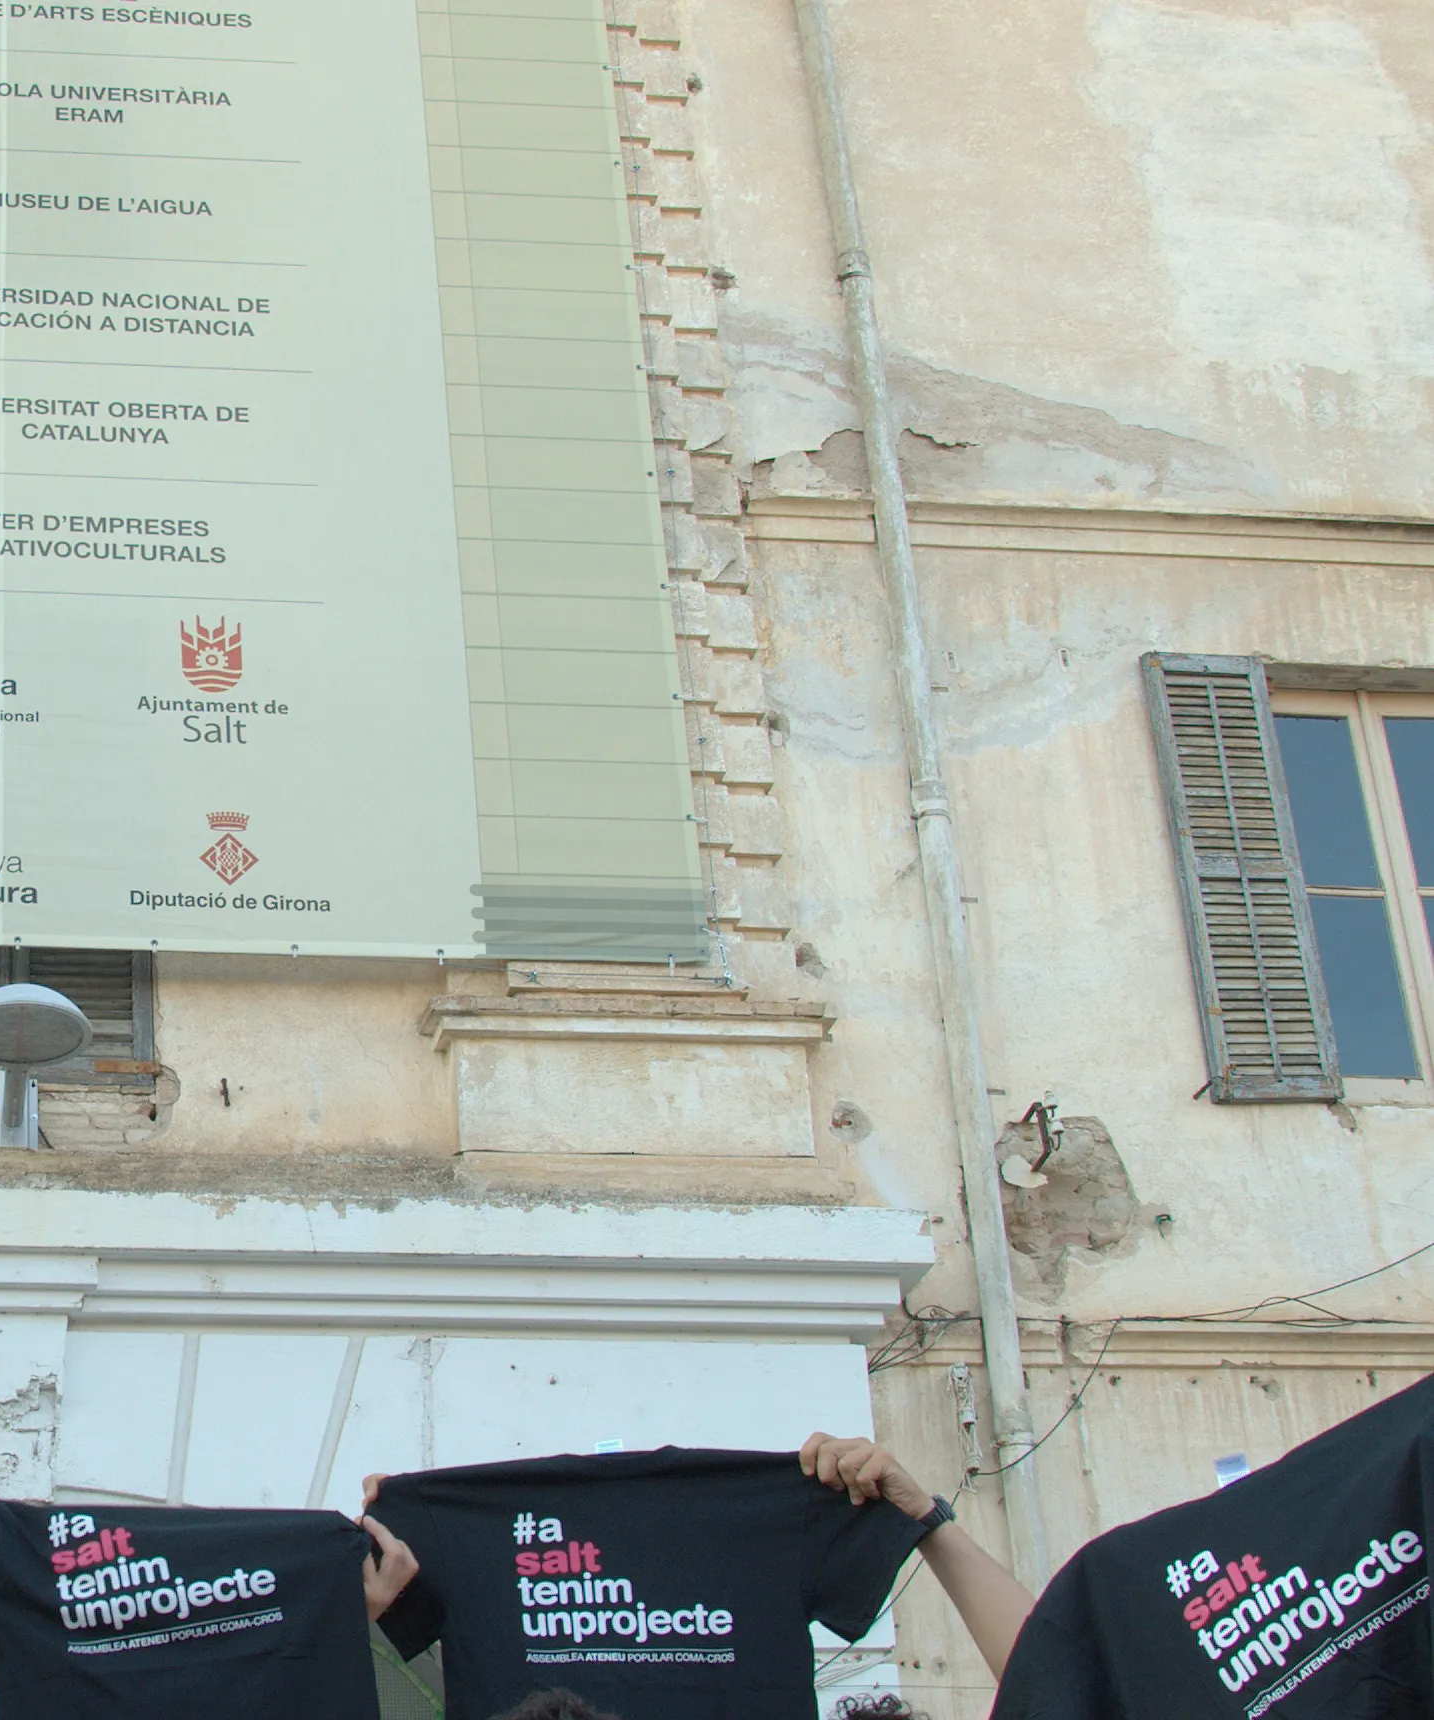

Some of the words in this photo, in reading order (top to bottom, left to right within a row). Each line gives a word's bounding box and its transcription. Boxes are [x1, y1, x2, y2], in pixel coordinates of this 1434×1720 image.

[10, 4, 94, 21] D'ARTS
[101, 6, 252, 28] ESCÈNIQUES
[51, 85, 232, 106] UNIVERSITÀRIA
[55, 107, 123, 123] ERAM
[78, 196, 110, 211] DE
[118, 198, 212, 216] L'AIGUA
[102, 292, 229, 312] NACIONAL
[238, 298, 270, 313] DE
[100, 316, 116, 331] A
[124, 317, 254, 336] DISTANCIA
[108, 402, 208, 421] OBERTA
[216, 407, 249, 422] DE
[21, 423, 168, 444] CATALUNYA
[43, 515, 209, 537] D'EMPRESES
[137, 696, 258, 714] Ajuntament
[264, 700, 289, 714] de
[183, 715, 247, 744] Salt
[130, 890, 227, 910] Diputació
[232, 894, 257, 909] de
[263, 895, 331, 912] Girona
[47, 1512, 95, 1547] #a
[513, 1512, 563, 1545] #a
[50, 1527, 135, 1574] salt
[516, 1541, 602, 1575] salt
[56, 1556, 170, 1601] tenim
[518, 1572, 633, 1606] tenim
[1166, 1550, 1219, 1599] #a
[60, 1568, 276, 1630] unprojecte
[1184, 1553, 1267, 1630] salt
[521, 1602, 733, 1643] unprojecte
[1197, 1566, 1308, 1660] tenim
[1218, 1530, 1423, 1692] unprojecte
[128, 1633, 170, 1650] ATENEU
[171, 1623, 219, 1642] POPULAR
[585, 1652, 626, 1662] ATENEU
[628, 1653, 674, 1663] POPULAR
[1299, 1643, 1339, 1681] ATENEU
